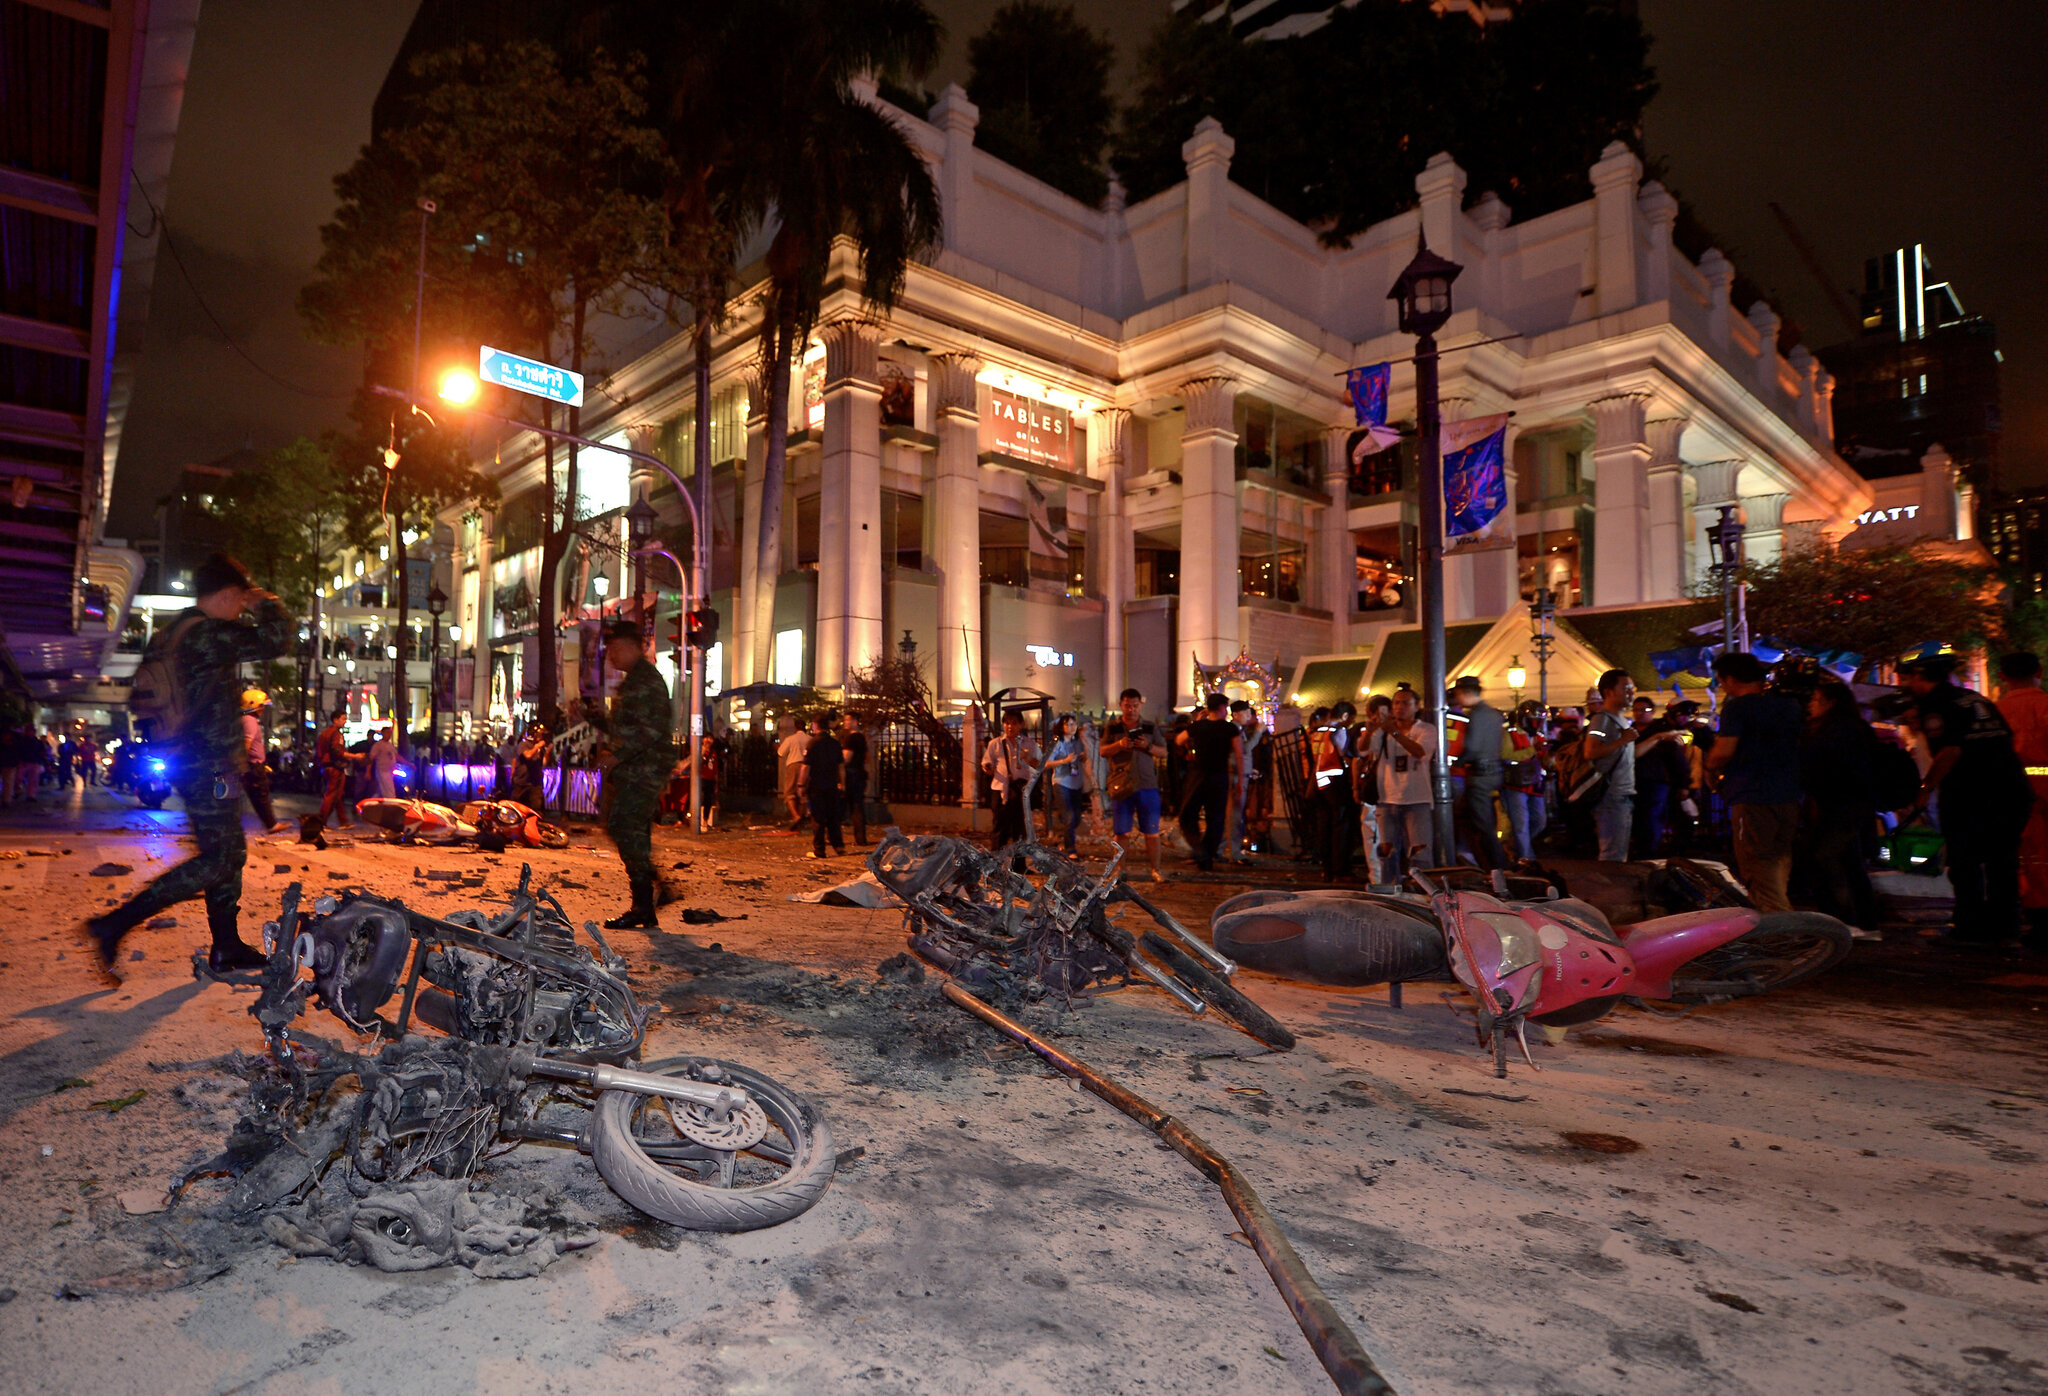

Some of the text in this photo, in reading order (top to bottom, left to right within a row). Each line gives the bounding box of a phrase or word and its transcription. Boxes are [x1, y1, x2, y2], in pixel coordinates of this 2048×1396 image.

[992, 399, 1063, 435] TABLES
[1850, 505, 1920, 525] YATT
[1456, 536, 1479, 545] VISA
